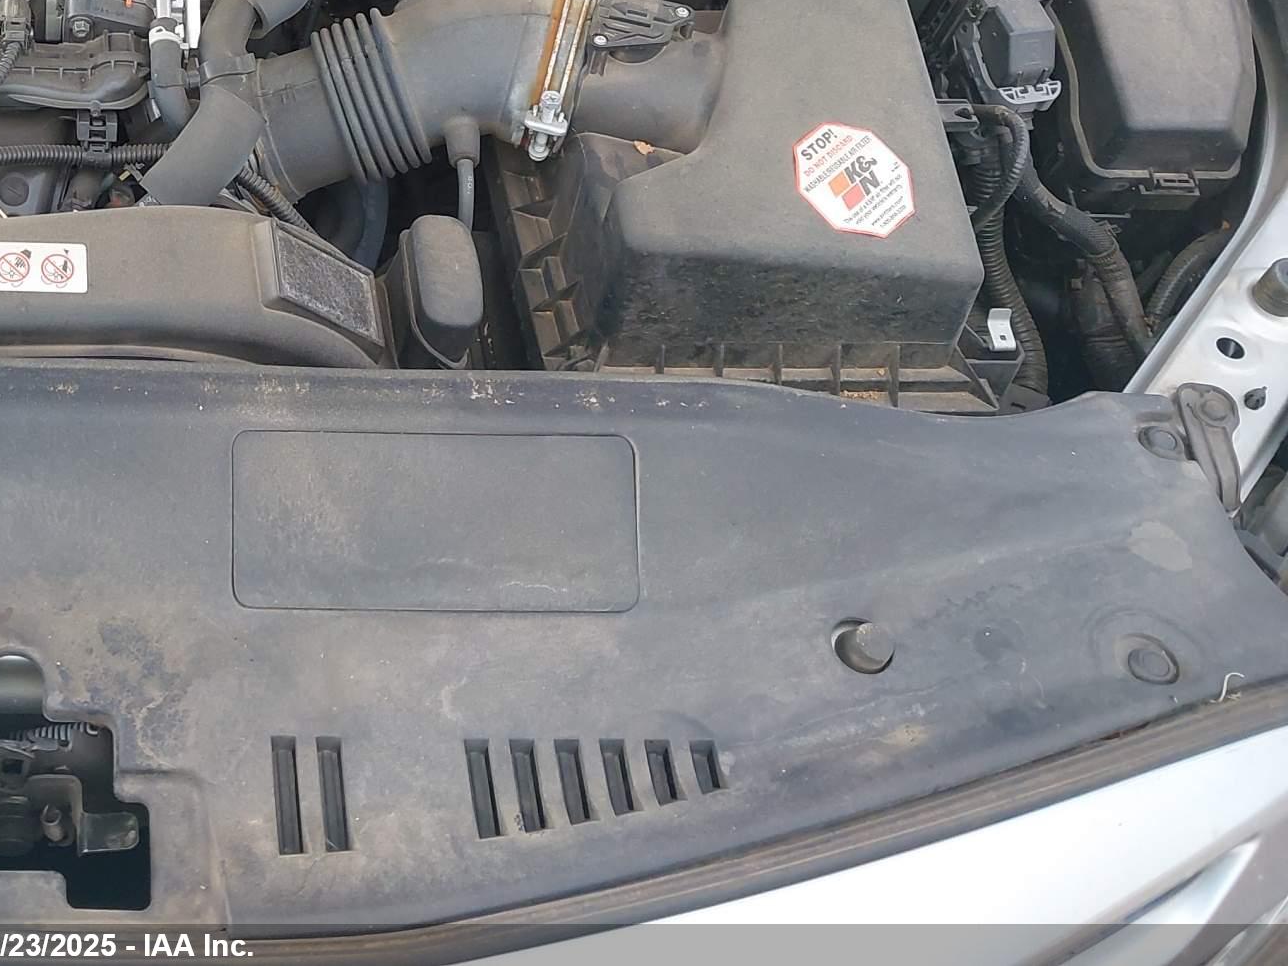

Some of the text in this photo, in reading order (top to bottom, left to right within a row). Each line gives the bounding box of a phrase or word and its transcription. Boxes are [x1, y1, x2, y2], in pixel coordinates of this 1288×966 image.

[800, 128, 837, 160] STOP!
[803, 134, 853, 176] DO NOT DISCARD
[847, 146, 858, 156] AIR
[854, 134, 872, 150] FILTER
